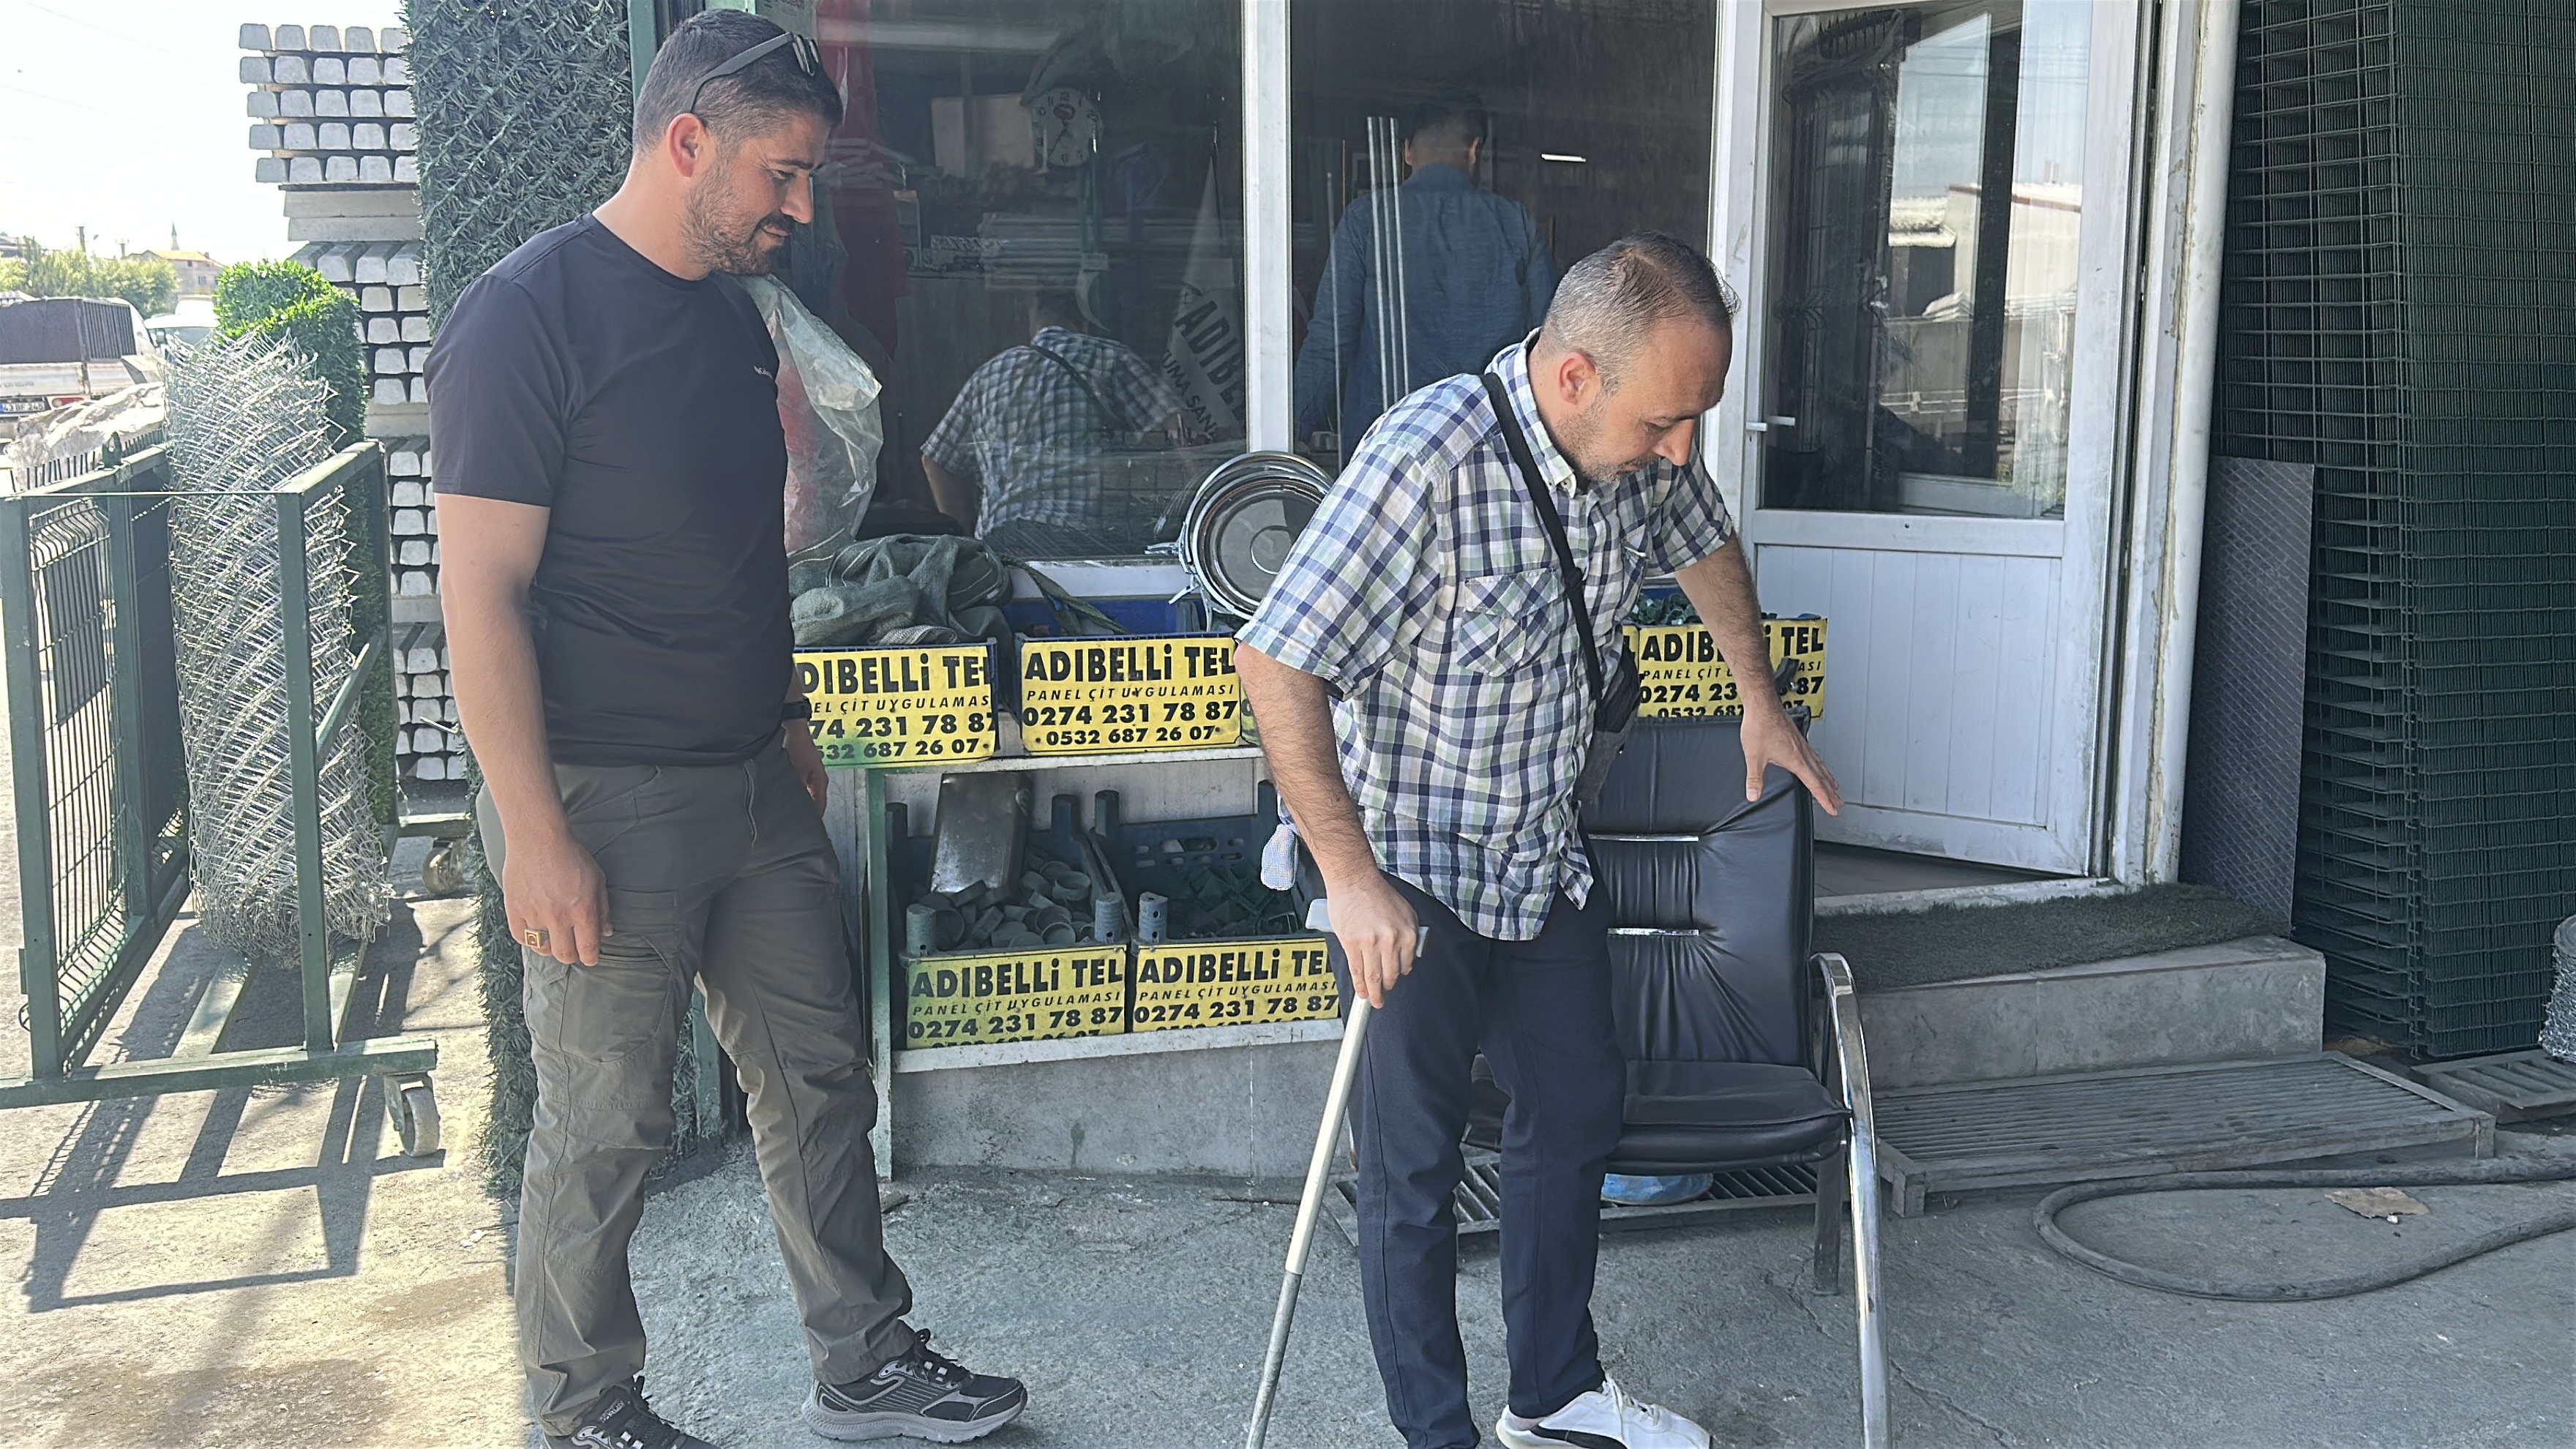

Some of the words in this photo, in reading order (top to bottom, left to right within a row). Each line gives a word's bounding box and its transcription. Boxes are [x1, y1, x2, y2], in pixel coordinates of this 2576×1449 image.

[1781, 626, 1824, 656] TEL
[1184, 646, 1236, 678] TEL
[1643, 669, 1690, 680] PANEL
[1698, 666, 1721, 681] ÇİT
[1027, 689, 1082, 701] PANEL
[1089, 686, 1115, 703] ÇİT
[1122, 684, 1234, 697] UYGULAMASI
[1640, 684, 1699, 703] 0274
[1709, 682, 1737, 701] 23
[841, 698, 869, 715] ÇİT
[1022, 705, 1093, 726] 0274
[1102, 704, 1150, 724] 231
[1164, 702, 1196, 722] 78
[1205, 700, 1238, 720] 87
[856, 716, 907, 738] 231
[922, 714, 957, 735] 78
[1046, 731, 1101, 746] 0532
[1108, 728, 1148, 743] 687
[1156, 727, 1182, 741] 26
[1189, 725, 1216, 741] 07
[864, 742, 907, 758] 687
[915, 739, 943, 755] 26
[951, 738, 980, 754] 07
[1071, 959, 1123, 988] TEL
[1139, 989, 1190, 1001] PANEL
[1198, 985, 1224, 1000] ÇİT
[1229, 981, 1336, 997] UYGULAMASI
[913, 1003, 967, 1016] PANEL
[976, 1000, 1001, 1014] ÇİT
[1007, 992, 1120, 1011] UYGULAMASI
[1134, 1003, 1199, 1023] 0274
[1210, 1000, 1254, 1018] 231
[1268, 997, 1298, 1014] 78
[1306, 995, 1338, 1011] 87
[907, 1019, 979, 1039] 0274
[988, 1013, 1036, 1035] 231
[1049, 1009, 1081, 1028] 78
[1091, 1006, 1123, 1025] 87
